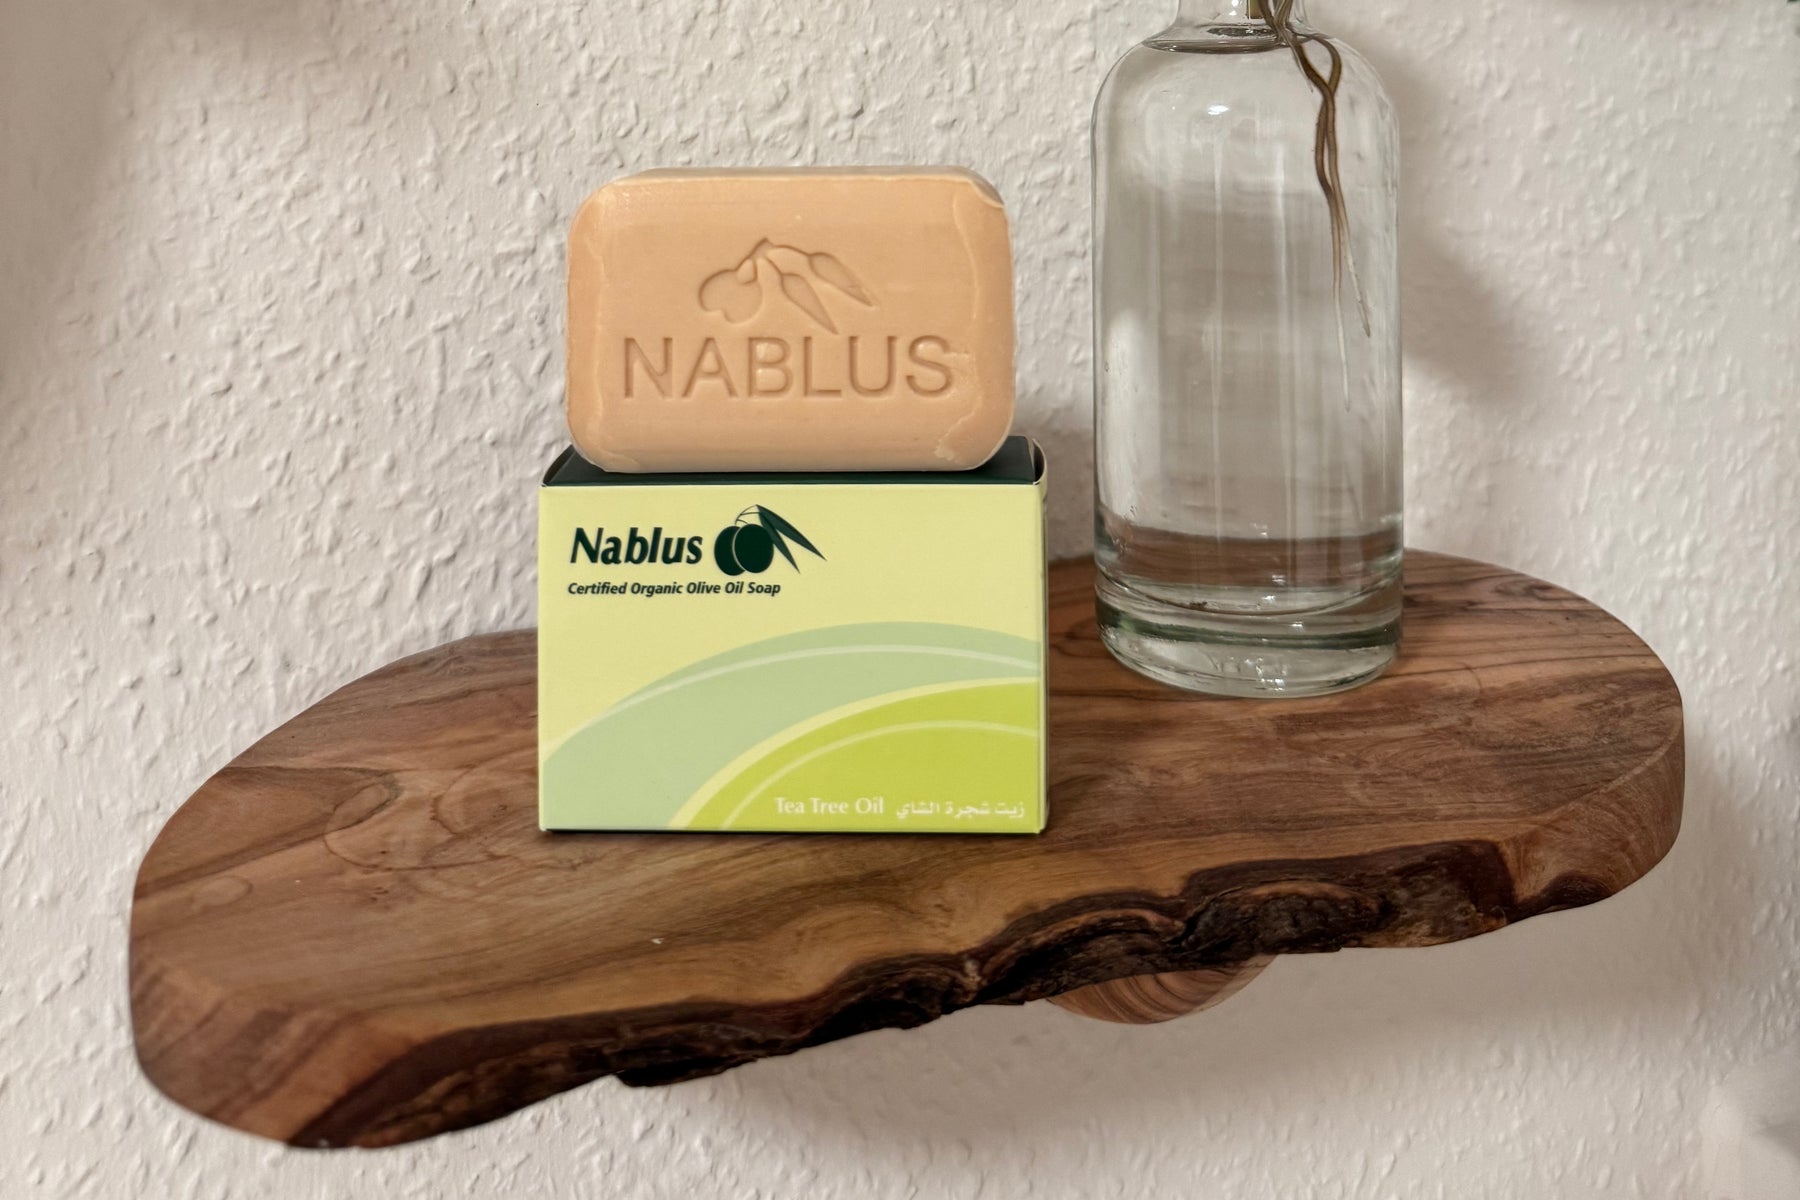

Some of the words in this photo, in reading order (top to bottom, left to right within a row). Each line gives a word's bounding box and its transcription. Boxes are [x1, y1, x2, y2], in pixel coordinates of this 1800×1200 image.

[623, 334, 955, 399] NABLUS
[570, 527, 703, 564] Nablus
[567, 581, 628, 595] Certified
[630, 582, 683, 597] Organic
[686, 581, 722, 594] Olive
[724, 581, 744, 594] Oil
[747, 582, 781, 596] Soap
[776, 797, 805, 814] Tea
[810, 797, 849, 814] Tree
[855, 796, 884, 814] Oil
[896, 801, 940, 819] الشاي
[945, 801, 990, 819] شجرة
[994, 801, 1025, 818] زيت
